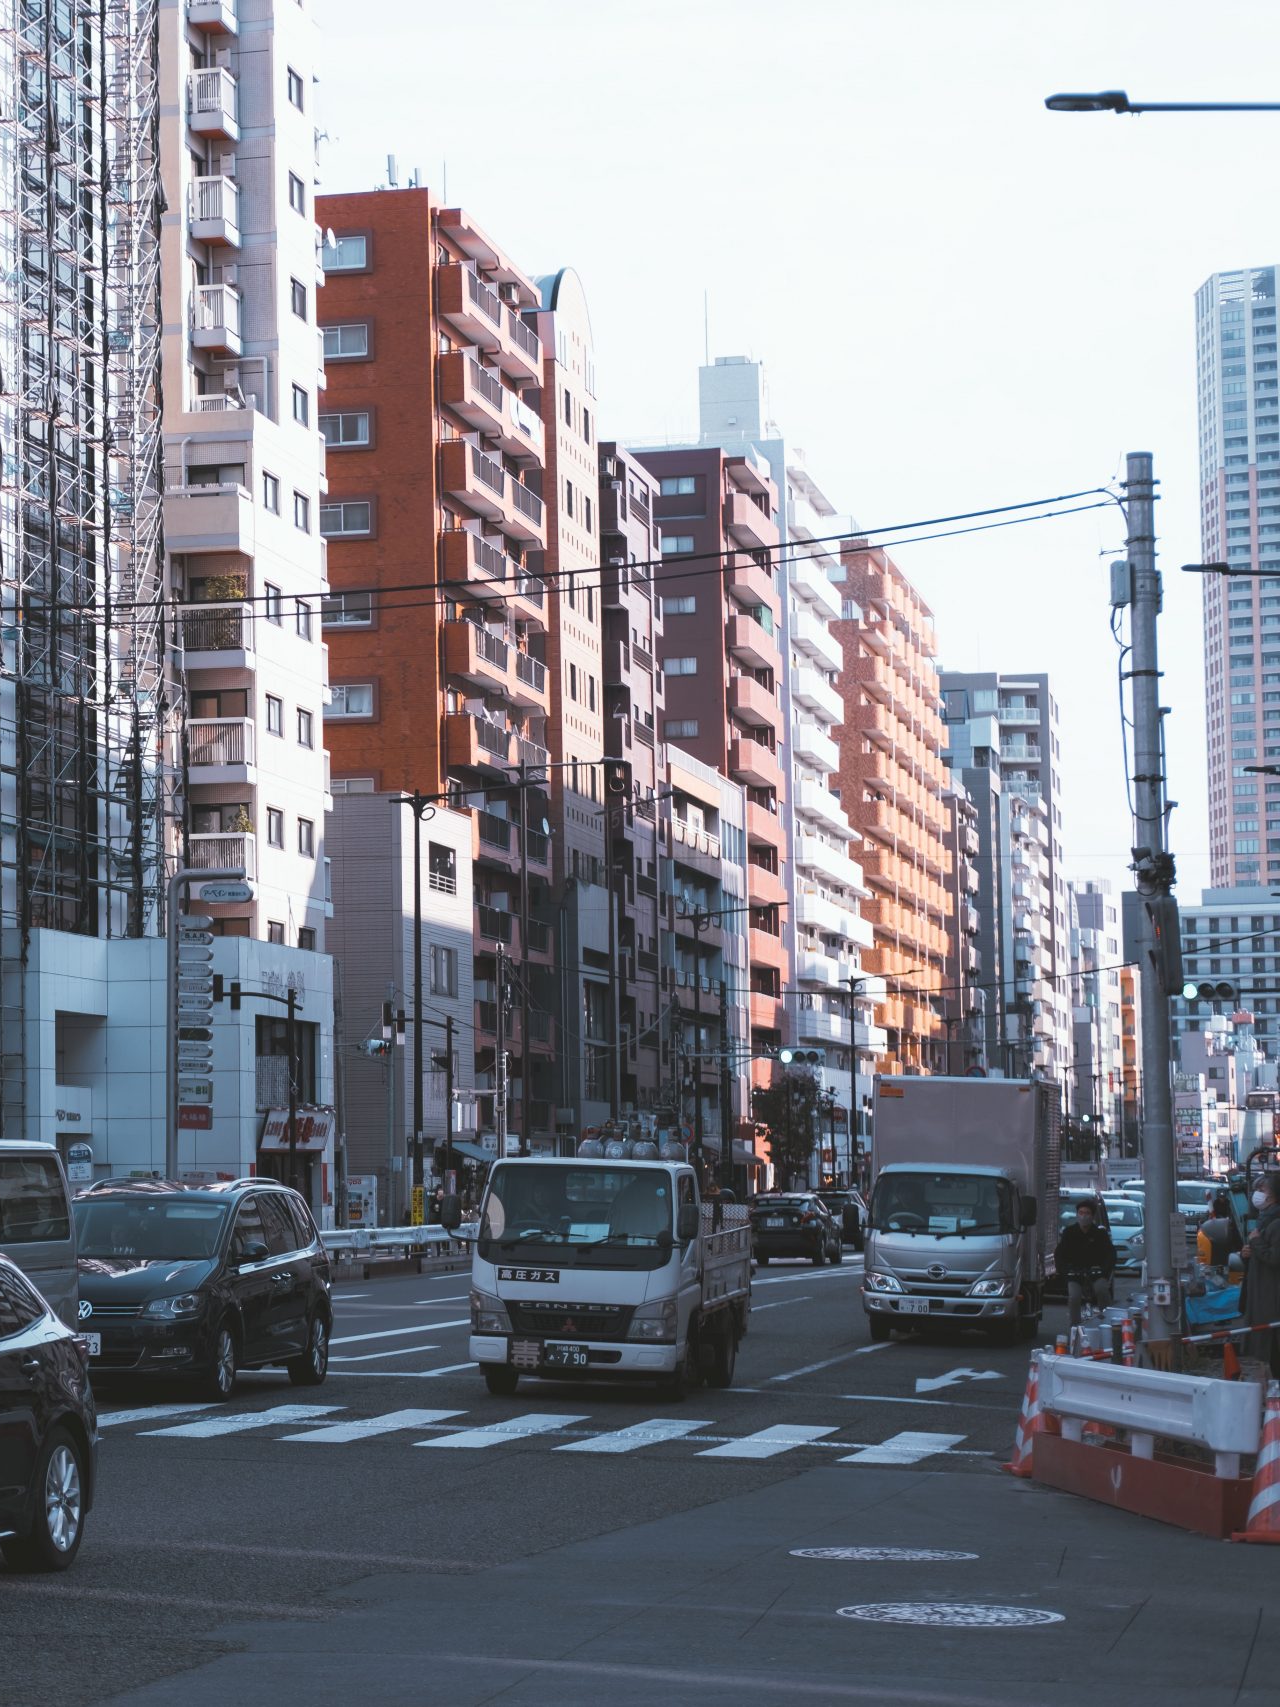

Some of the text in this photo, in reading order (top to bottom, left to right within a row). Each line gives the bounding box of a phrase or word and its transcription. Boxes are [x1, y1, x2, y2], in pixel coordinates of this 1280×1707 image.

[501, 1269, 555, 1281] 高圧ガス
[520, 1302, 620, 1311] CANTER
